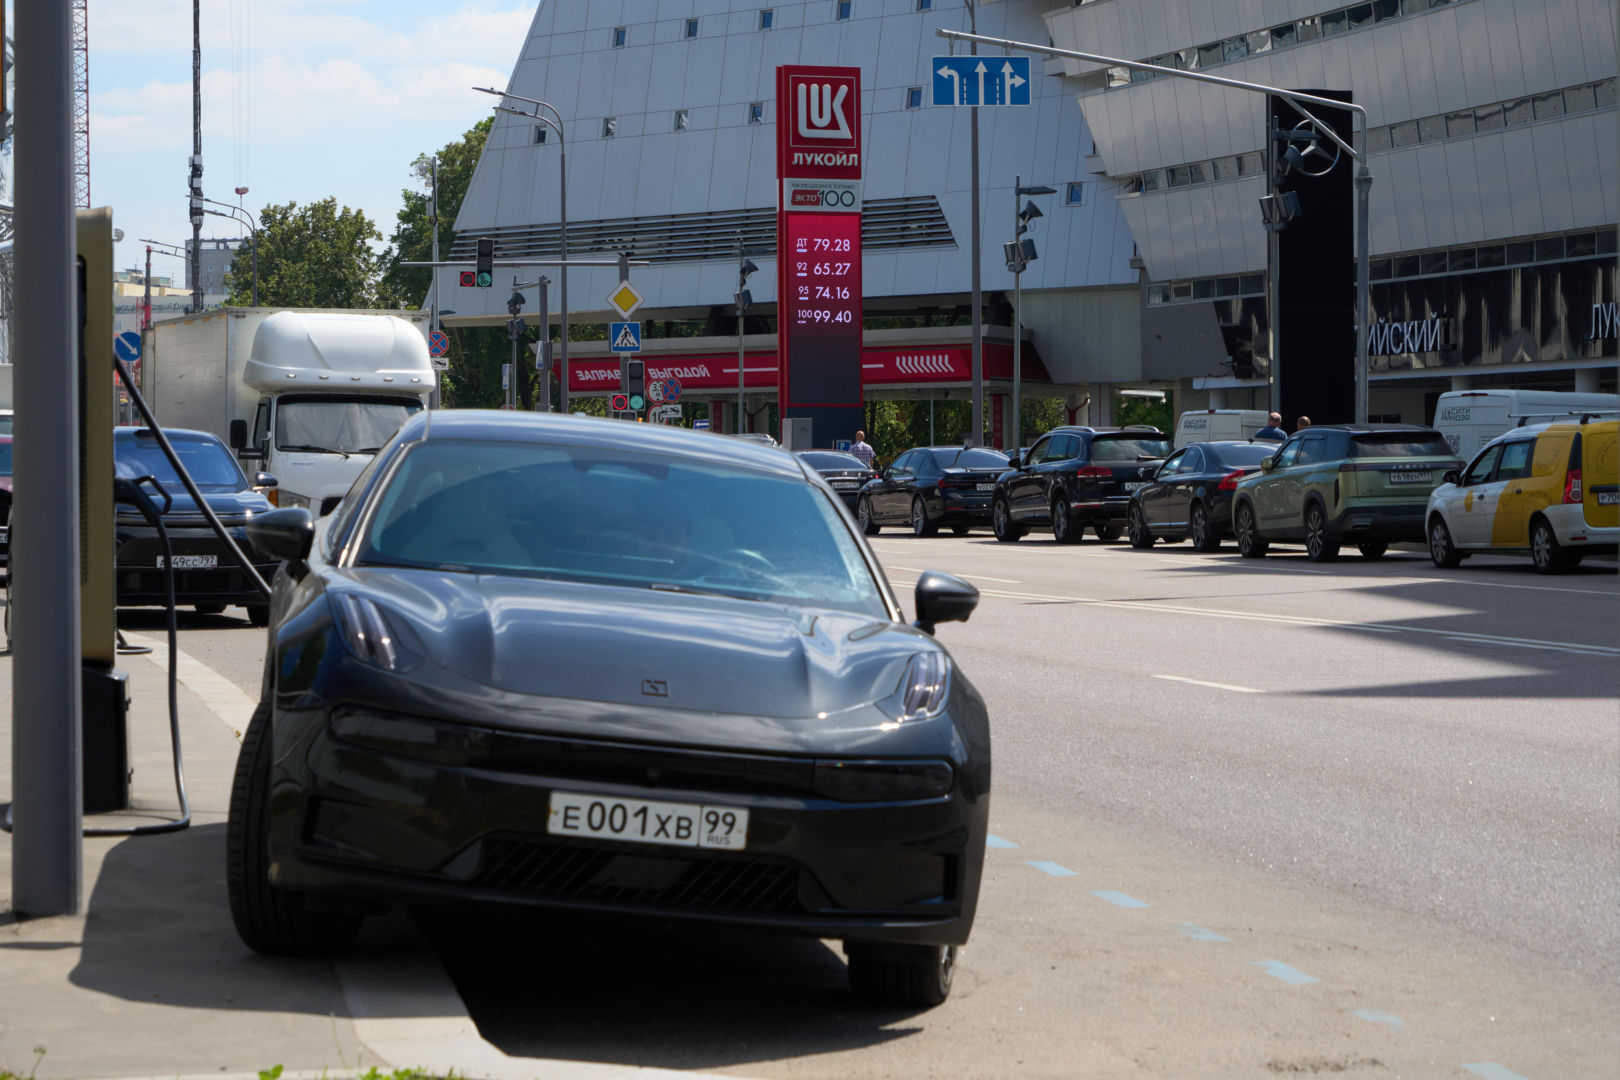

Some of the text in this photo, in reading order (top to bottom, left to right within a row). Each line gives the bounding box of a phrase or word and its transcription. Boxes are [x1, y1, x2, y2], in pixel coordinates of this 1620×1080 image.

[792, 151, 859, 167] ЛУКОЙЛ
[794, 194, 817, 202] ЭКТО
[796, 238, 851, 252] ДТ 79.28
[796, 262, 852, 276] 92 65.27
[798, 286, 850, 300] 95 74.16
[797, 309, 852, 324] 100 99.40
[647, 364, 711, 379] ВЫГОДОЙ
[160, 557, 198, 567] А49СС
[562, 801, 737, 840] Е001ХВ 99
[706, 834, 731, 846] RUS
